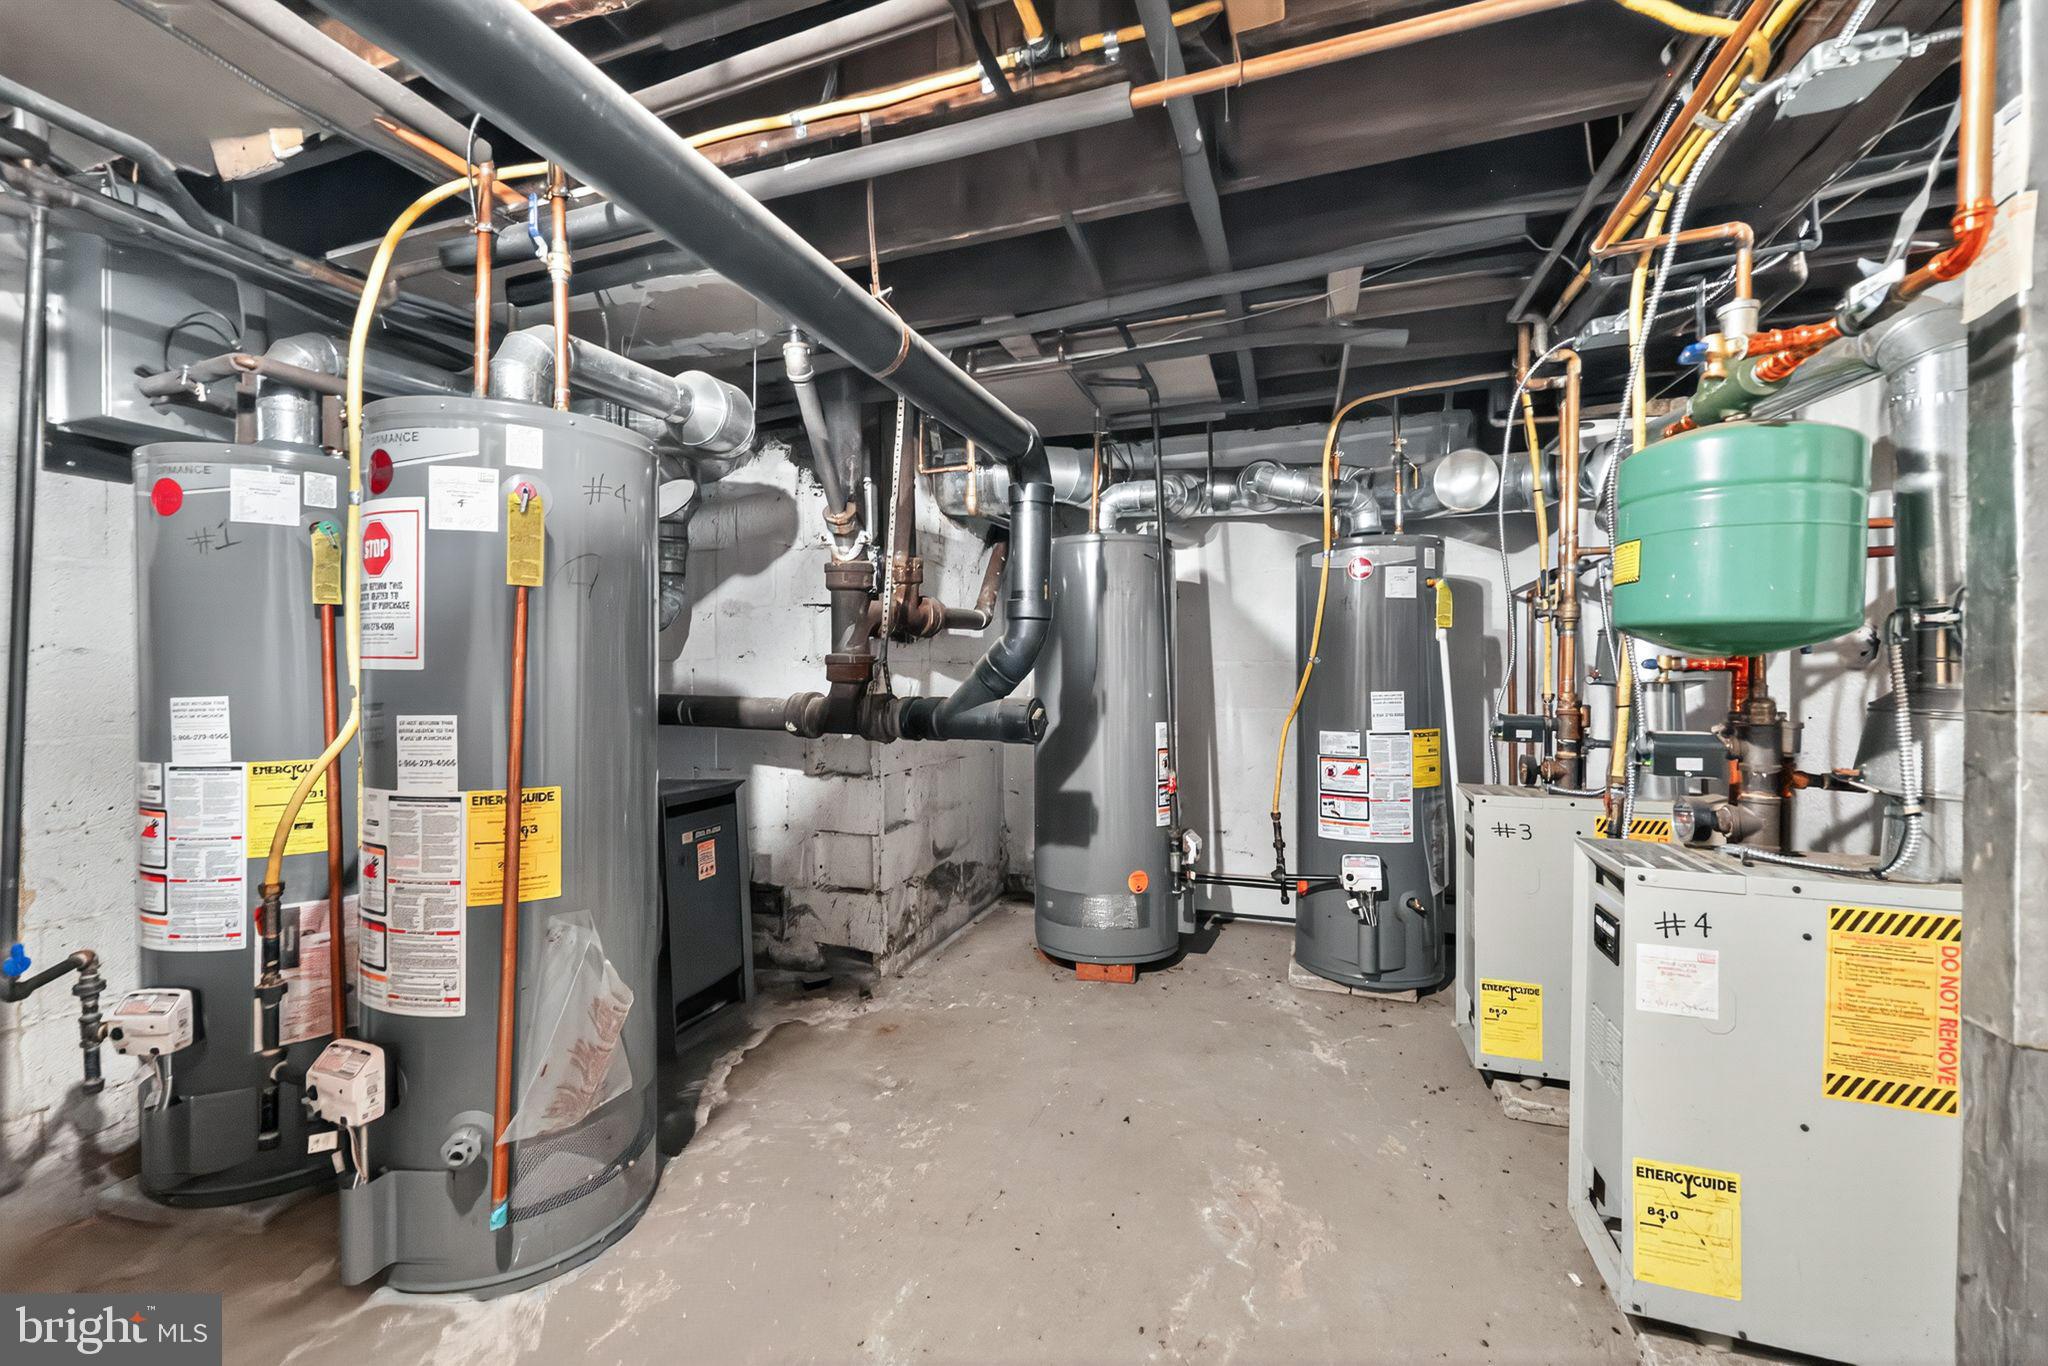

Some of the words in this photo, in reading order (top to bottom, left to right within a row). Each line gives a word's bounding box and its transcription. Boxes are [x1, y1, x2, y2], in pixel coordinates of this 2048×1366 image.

[187, 519, 242, 554] #1
[364, 538, 389, 559] STOP
[1491, 821, 1533, 840] #3
[1654, 911, 1713, 938] #4
[1941, 945, 1960, 972] DO
[1939, 976, 1959, 1012] NOT
[1937, 1017, 1959, 1087] REMOVE
[1636, 1166, 1737, 1196] ENERGYGUIDE
[1647, 1206, 1679, 1220] 84.0
